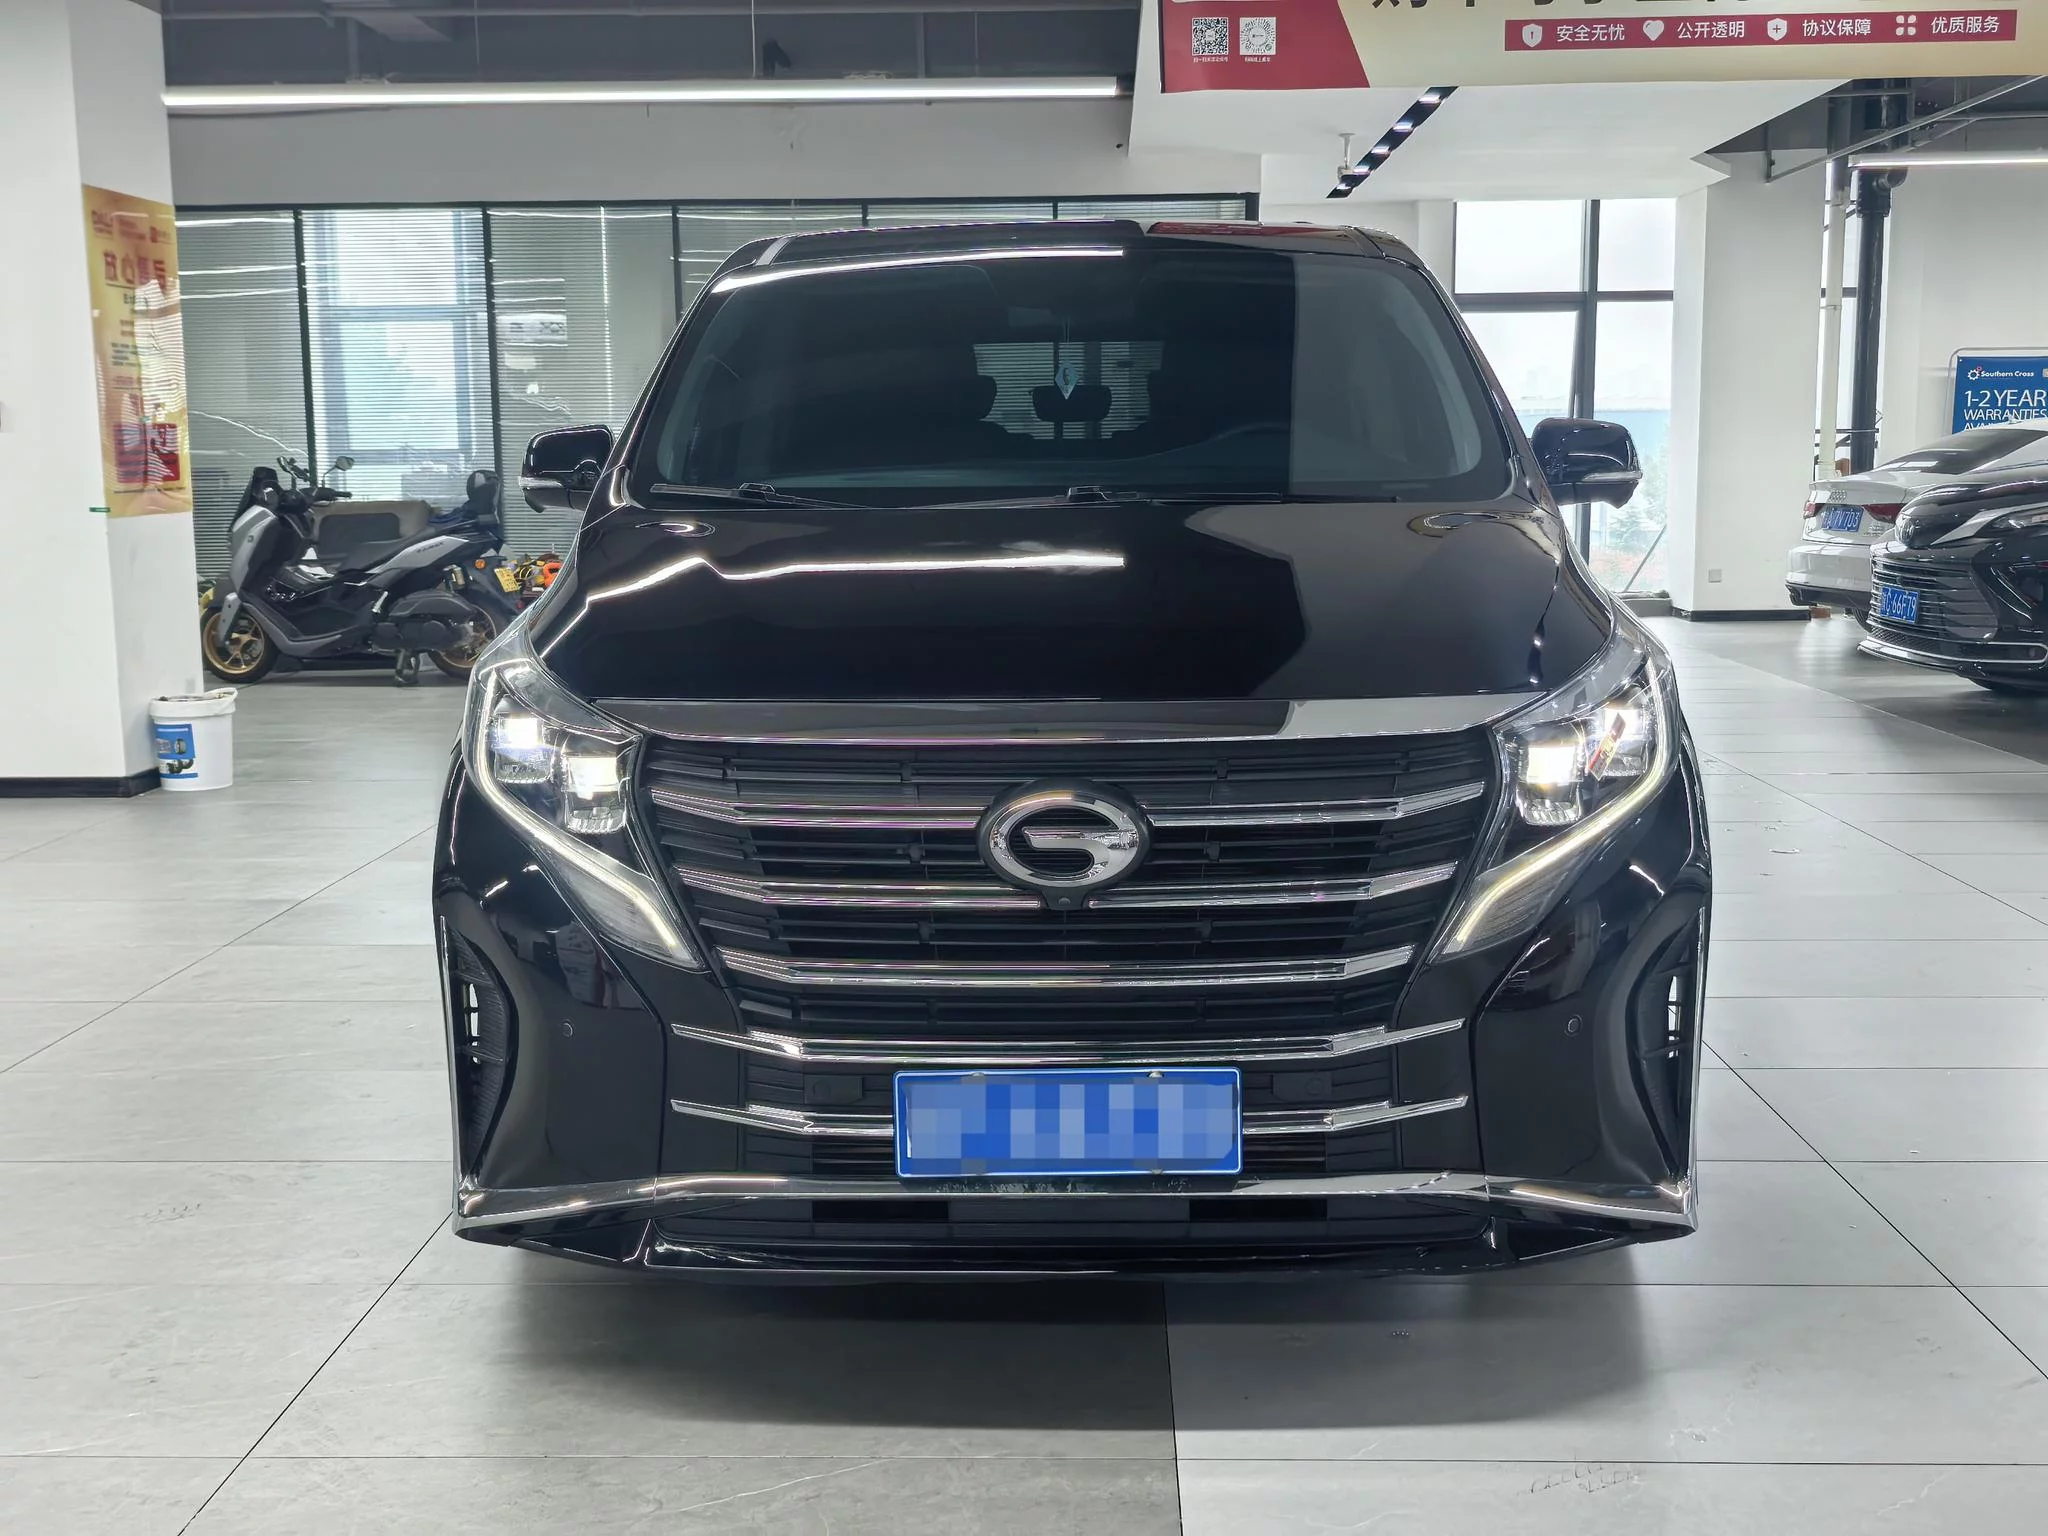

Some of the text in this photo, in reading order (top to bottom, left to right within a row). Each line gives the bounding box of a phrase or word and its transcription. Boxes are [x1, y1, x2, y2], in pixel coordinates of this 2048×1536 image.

[1556, 15, 2000, 42] 安全无忧 公开透明 协议保障 优质服务
[1964, 389, 2047, 407] 1-2 YEAR
